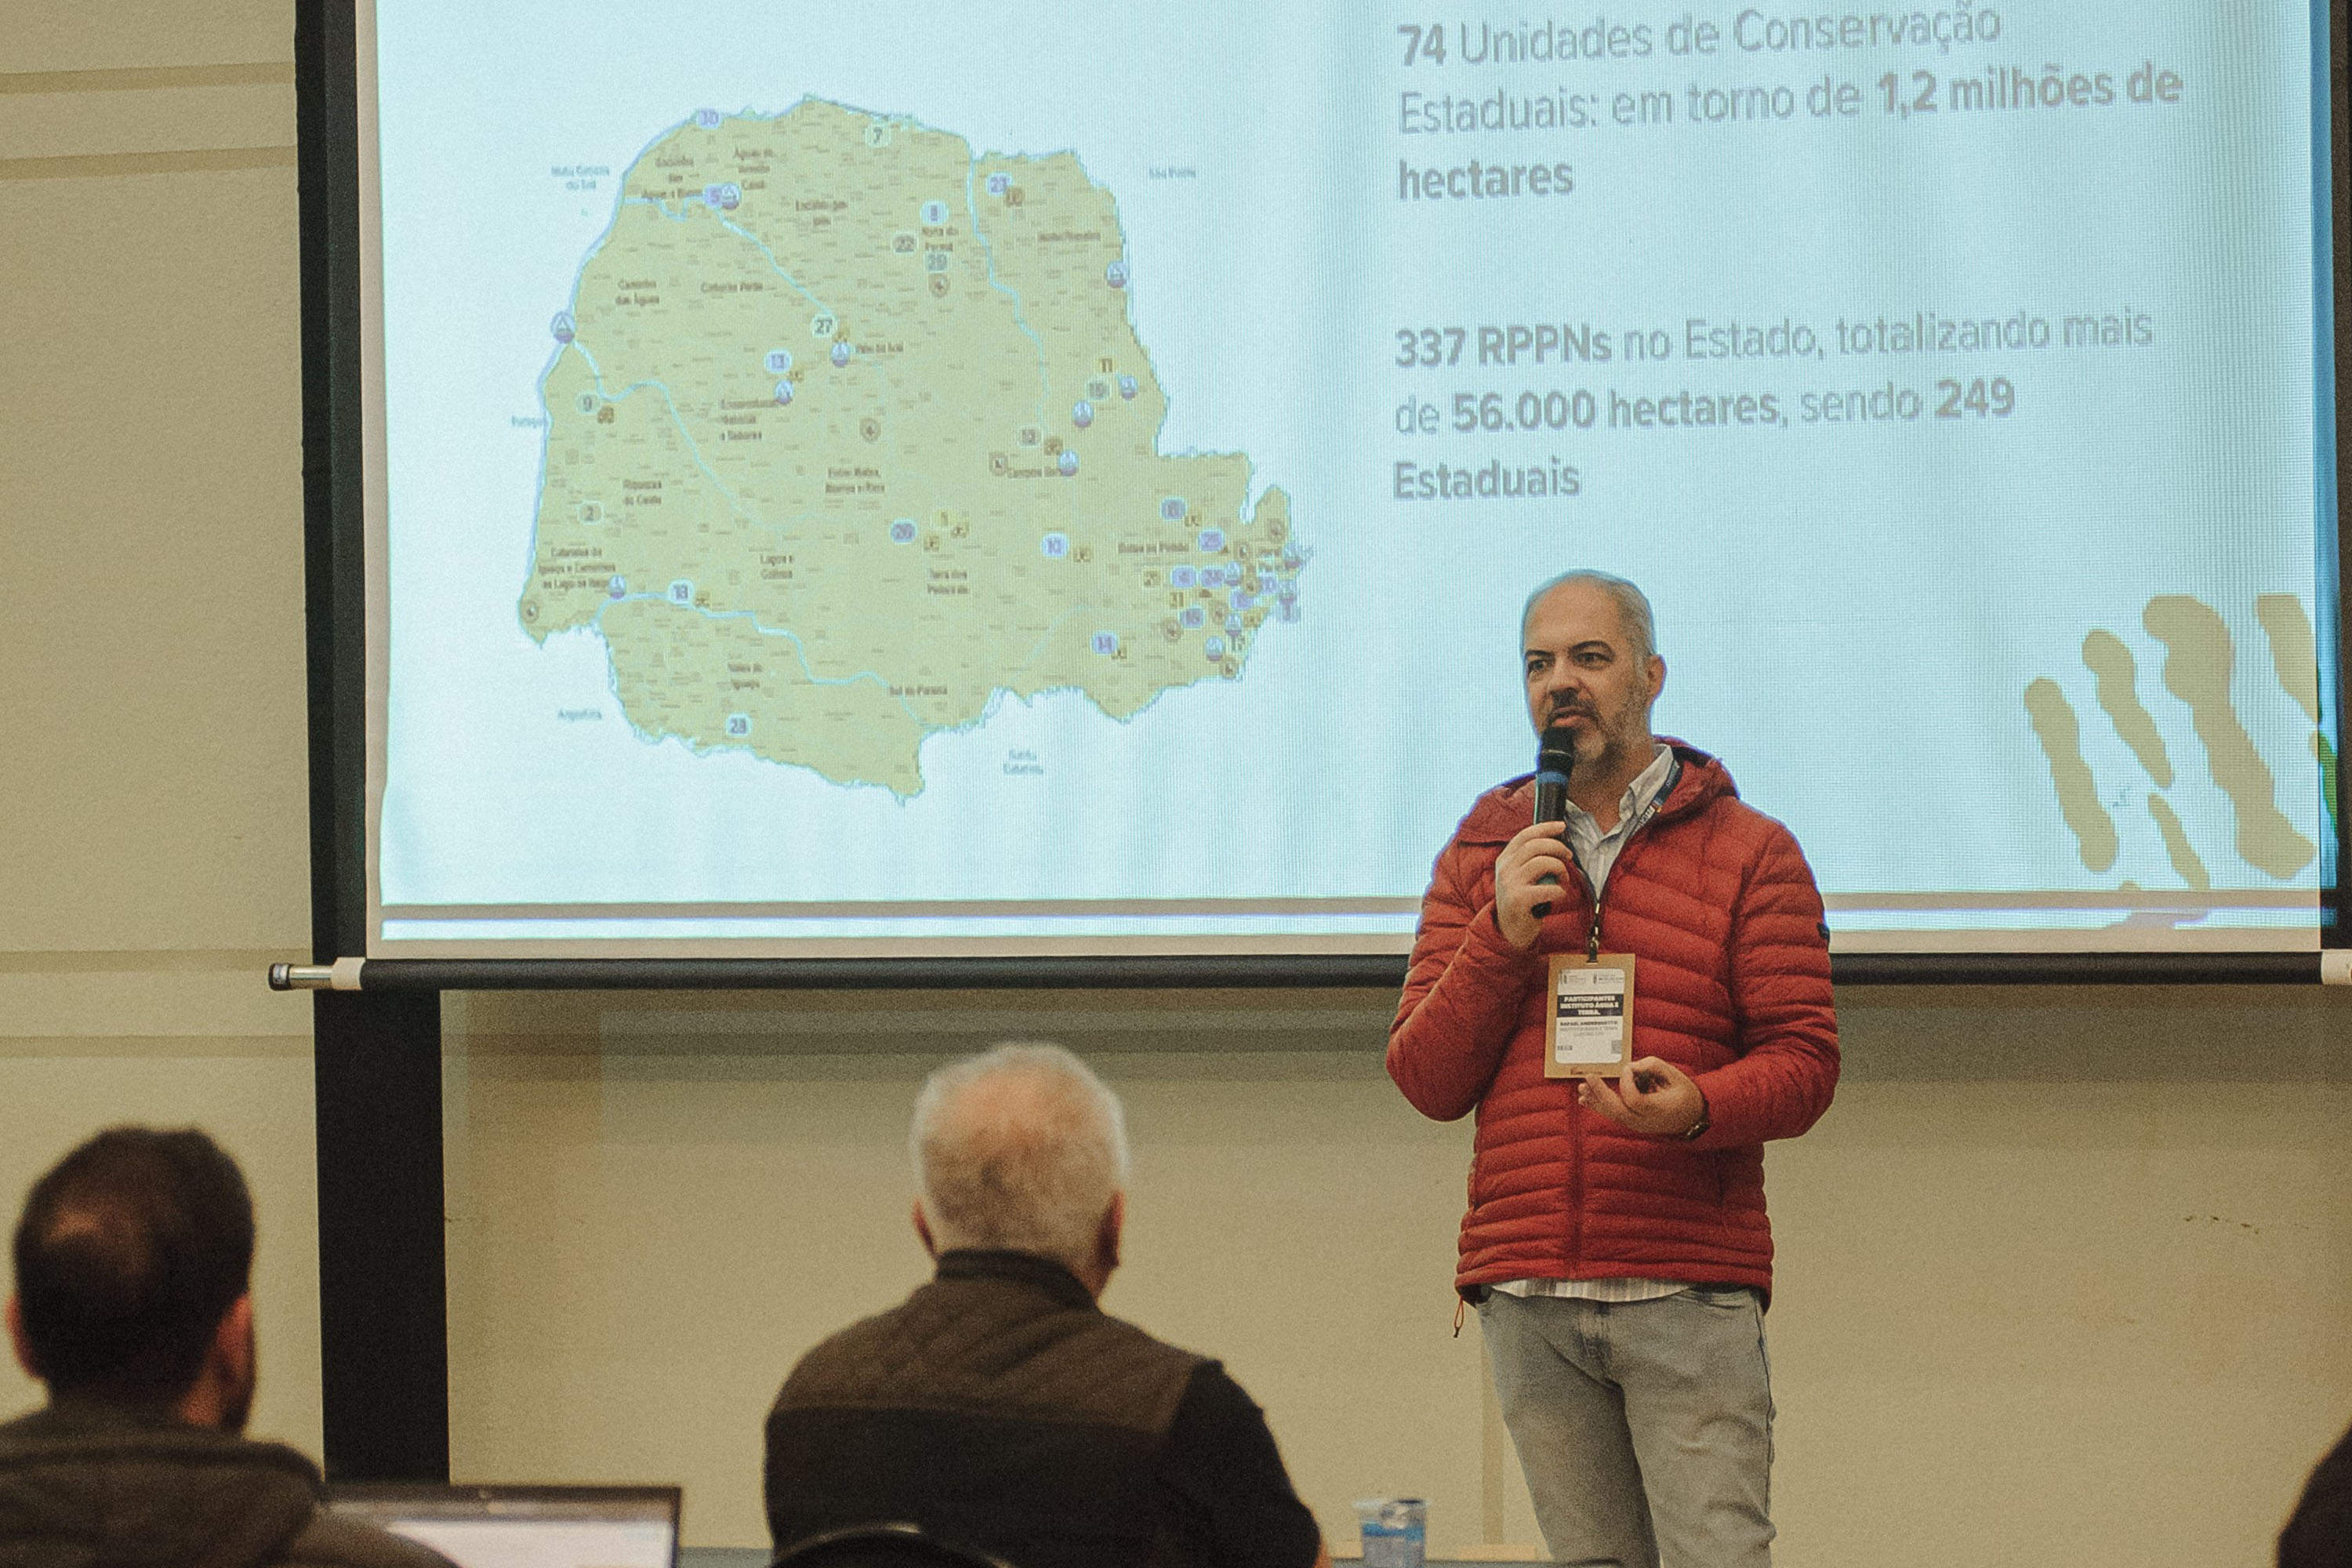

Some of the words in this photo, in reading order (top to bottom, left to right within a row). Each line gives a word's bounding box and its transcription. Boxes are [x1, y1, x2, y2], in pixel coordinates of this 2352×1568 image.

[1398, 24, 1446, 65] 74
[1461, 15, 1653, 64] Unidades
[1668, 12, 1719, 55] de
[1733, 0, 2001, 53] Conservação
[1400, 86, 1598, 133] Estaduais:
[1612, 89, 1673, 126] em
[1688, 82, 1794, 122] torno
[1807, 76, 1860, 116] de
[1879, 71, 1936, 118] 1,2
[1949, 63, 2114, 111] milhões
[2127, 62, 2183, 104] de
[1399, 159, 1573, 200] hectares
[815, 318, 833, 335] 27
[1396, 328, 1465, 366] 337
[1477, 324, 1611, 365] RPPNs
[1624, 327, 1671, 361] no
[1686, 317, 1824, 361] Estado,
[1836, 311, 2050, 354] totalizando
[2063, 308, 2153, 347] mais
[1396, 394, 1439, 434] de
[1452, 390, 1595, 431] 56.000
[1608, 386, 1788, 429] hectares,
[1801, 382, 1922, 423] sendo
[1934, 377, 2015, 418] 249
[1394, 456, 1580, 499] Estaduais
[729, 716, 748, 734] 28
